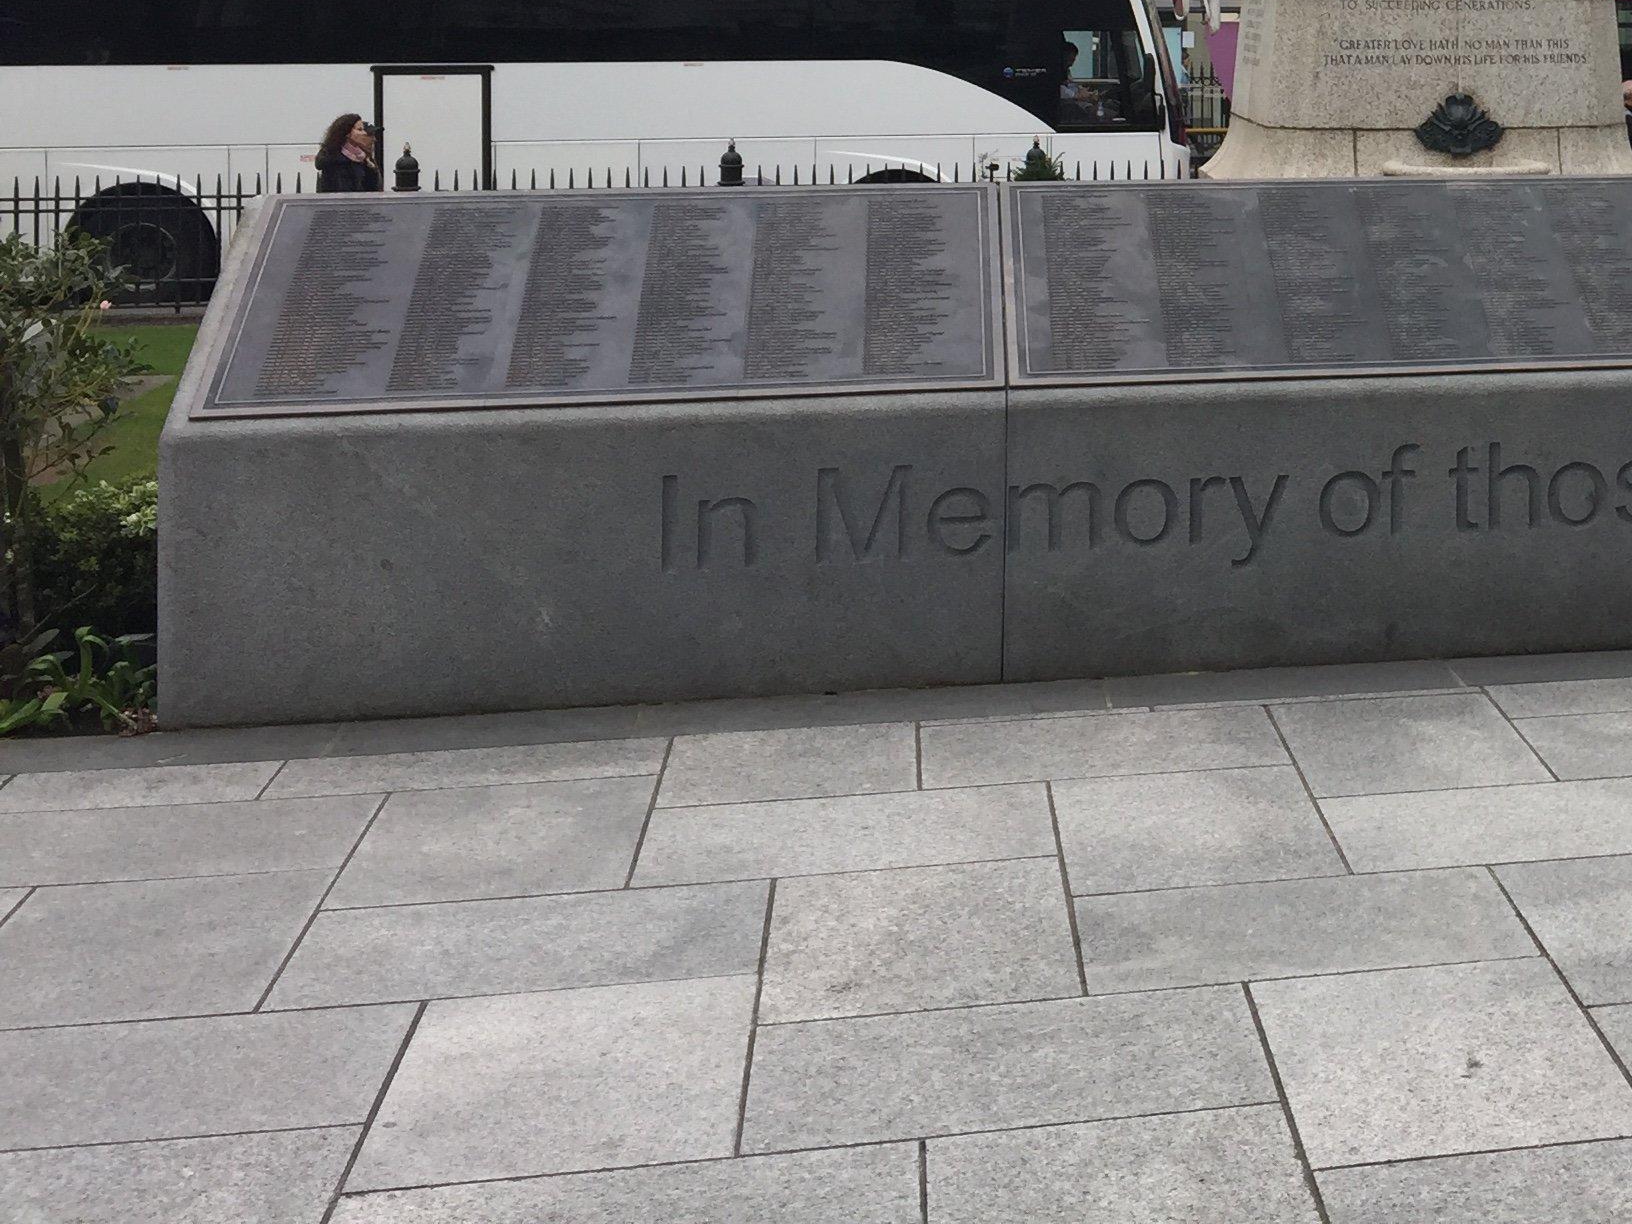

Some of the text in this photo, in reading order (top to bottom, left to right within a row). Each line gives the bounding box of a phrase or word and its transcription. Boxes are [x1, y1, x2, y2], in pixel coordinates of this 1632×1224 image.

[1340, 0, 1358, 11] TO
[1393, 39, 1425, 50] LOVE
[1429, 39, 1459, 50] HATH
[1464, 39, 1482, 50] NO
[1485, 39, 1510, 50] MAN
[1514, 39, 1543, 50] THAN
[1546, 39, 1570, 50] THIS
[1323, 54, 1352, 65] THAT
[1354, 54, 1363, 65] A
[1364, 54, 1389, 65] MAN
[1392, 54, 1412, 65] LAY
[1415, 54, 1451, 65] DOWN
[1453, 54, 1472, 65] HIS
[1474, 54, 1497, 65] LIFE
[1499, 54, 1520, 65] FOR
[1523, 54, 1541, 65] HIS
[660, 474, 756, 573] In
[814, 464, 1290, 569] Memory
[1317, 443, 1421, 538] of
